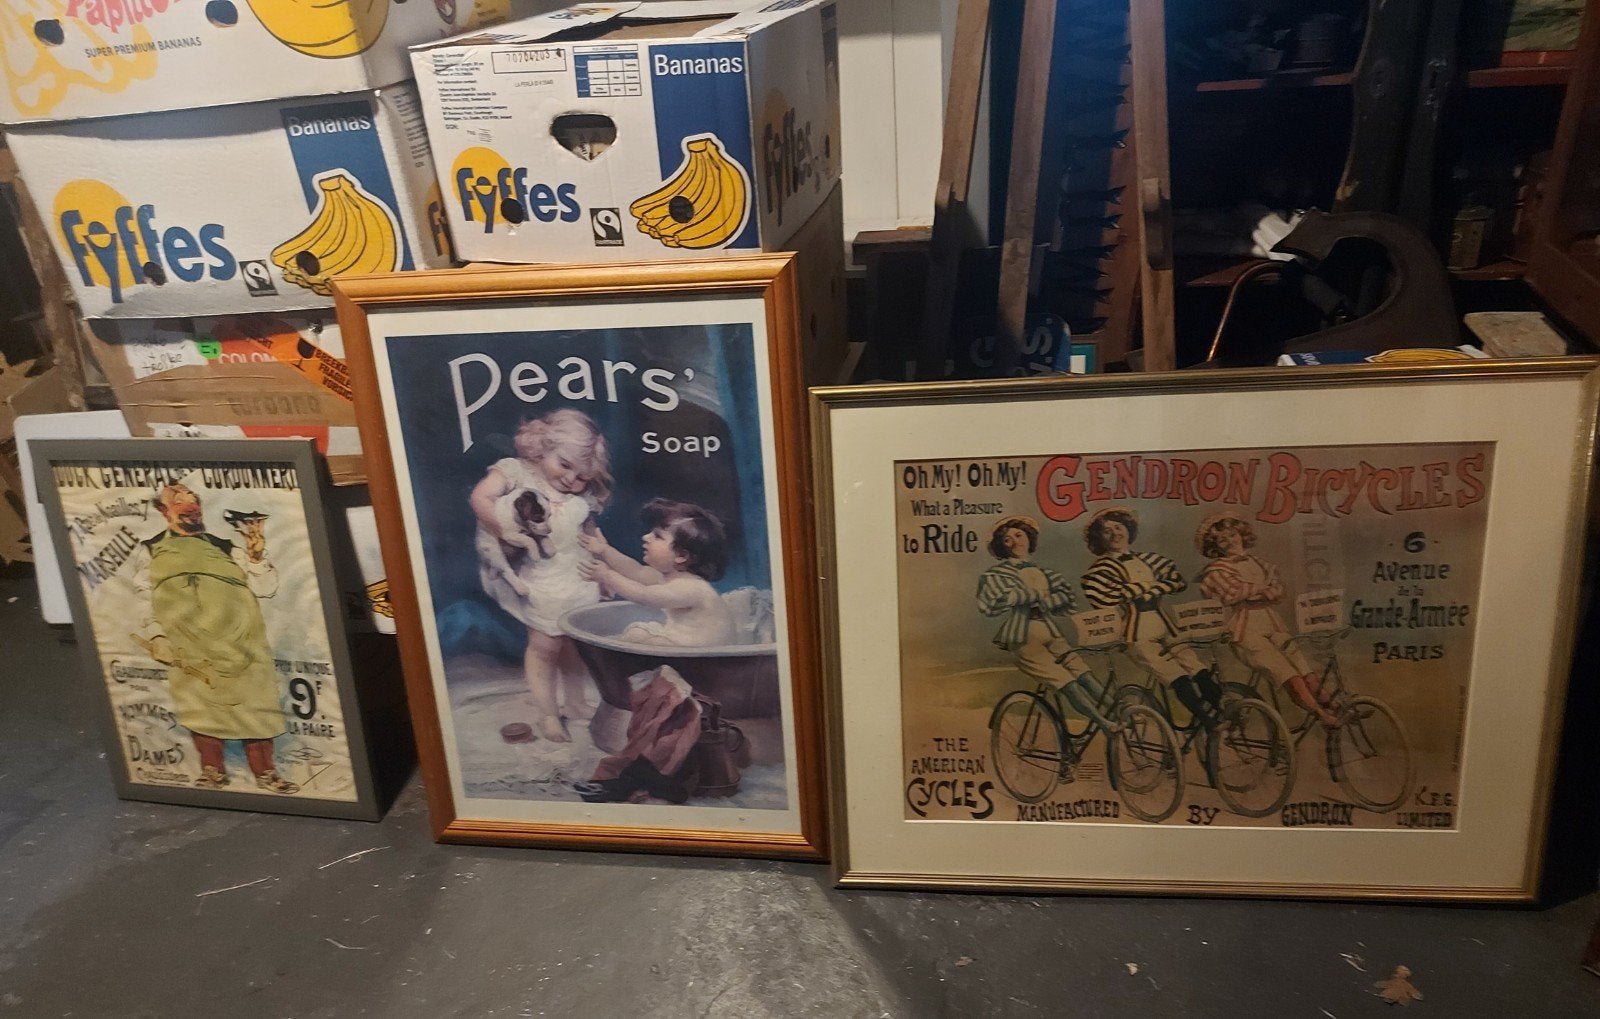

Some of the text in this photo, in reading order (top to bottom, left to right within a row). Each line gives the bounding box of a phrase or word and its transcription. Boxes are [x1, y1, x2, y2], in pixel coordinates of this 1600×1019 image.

[84, 37, 202, 58] SUPER PREMIUM BANANAS
[654, 54, 743, 76] Bananas
[288, 116, 372, 137] Bananas
[641, 432, 721, 458] Soap
[904, 461, 1027, 494] Oh My! Oh My!
[1037, 452, 1486, 524] GENDRON BICYCLES
[911, 499, 1003, 517] What a Pleasure
[903, 524, 978, 554] to Ride
[1372, 561, 1450, 583] Avenue
[1372, 642, 1444, 664] PARIS
[302, 722, 336, 738] PAIRE
[933, 737, 969, 753] THE
[911, 755, 985, 775] AMERICAN
[906, 777, 994, 820] CYCLES
[1017, 799, 1354, 828] MANUFACTURED BY GENDRON
